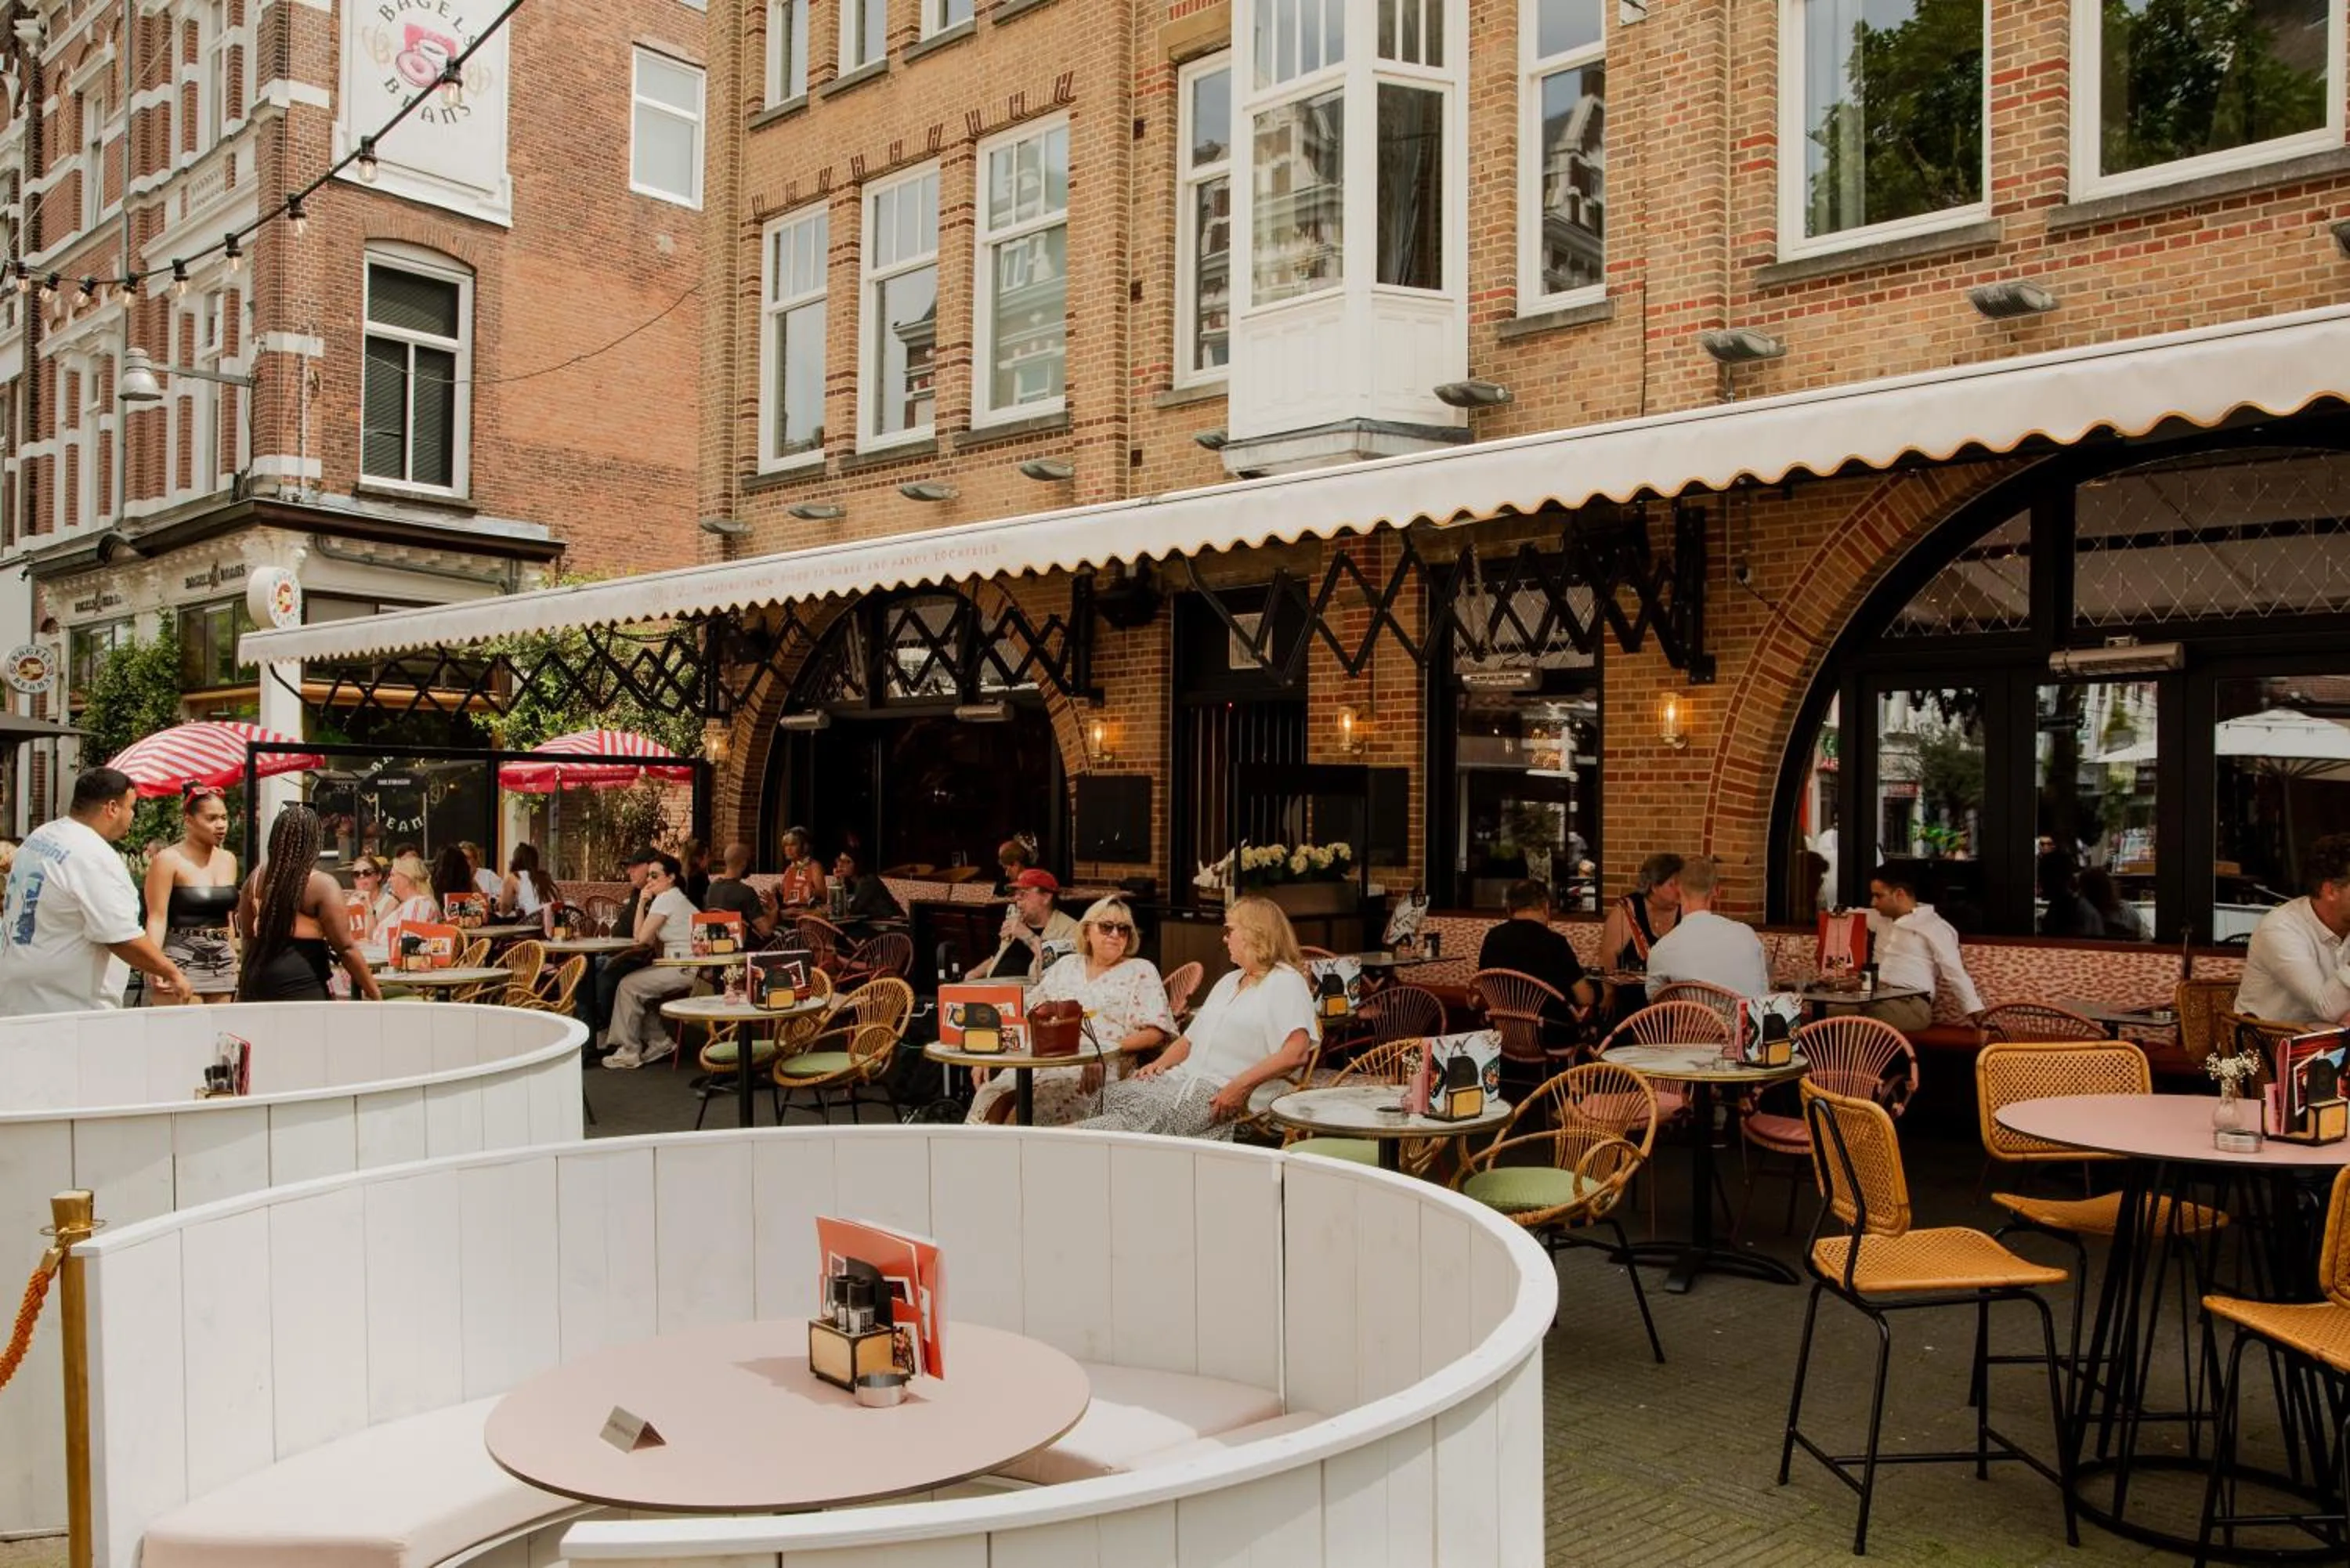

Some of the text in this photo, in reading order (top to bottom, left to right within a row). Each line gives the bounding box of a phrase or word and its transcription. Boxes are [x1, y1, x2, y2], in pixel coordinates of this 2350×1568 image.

[378, 0, 478, 48] BAGELS
[12, 647, 52, 665] BAGELS
[13, 677, 51, 691] BEANS
